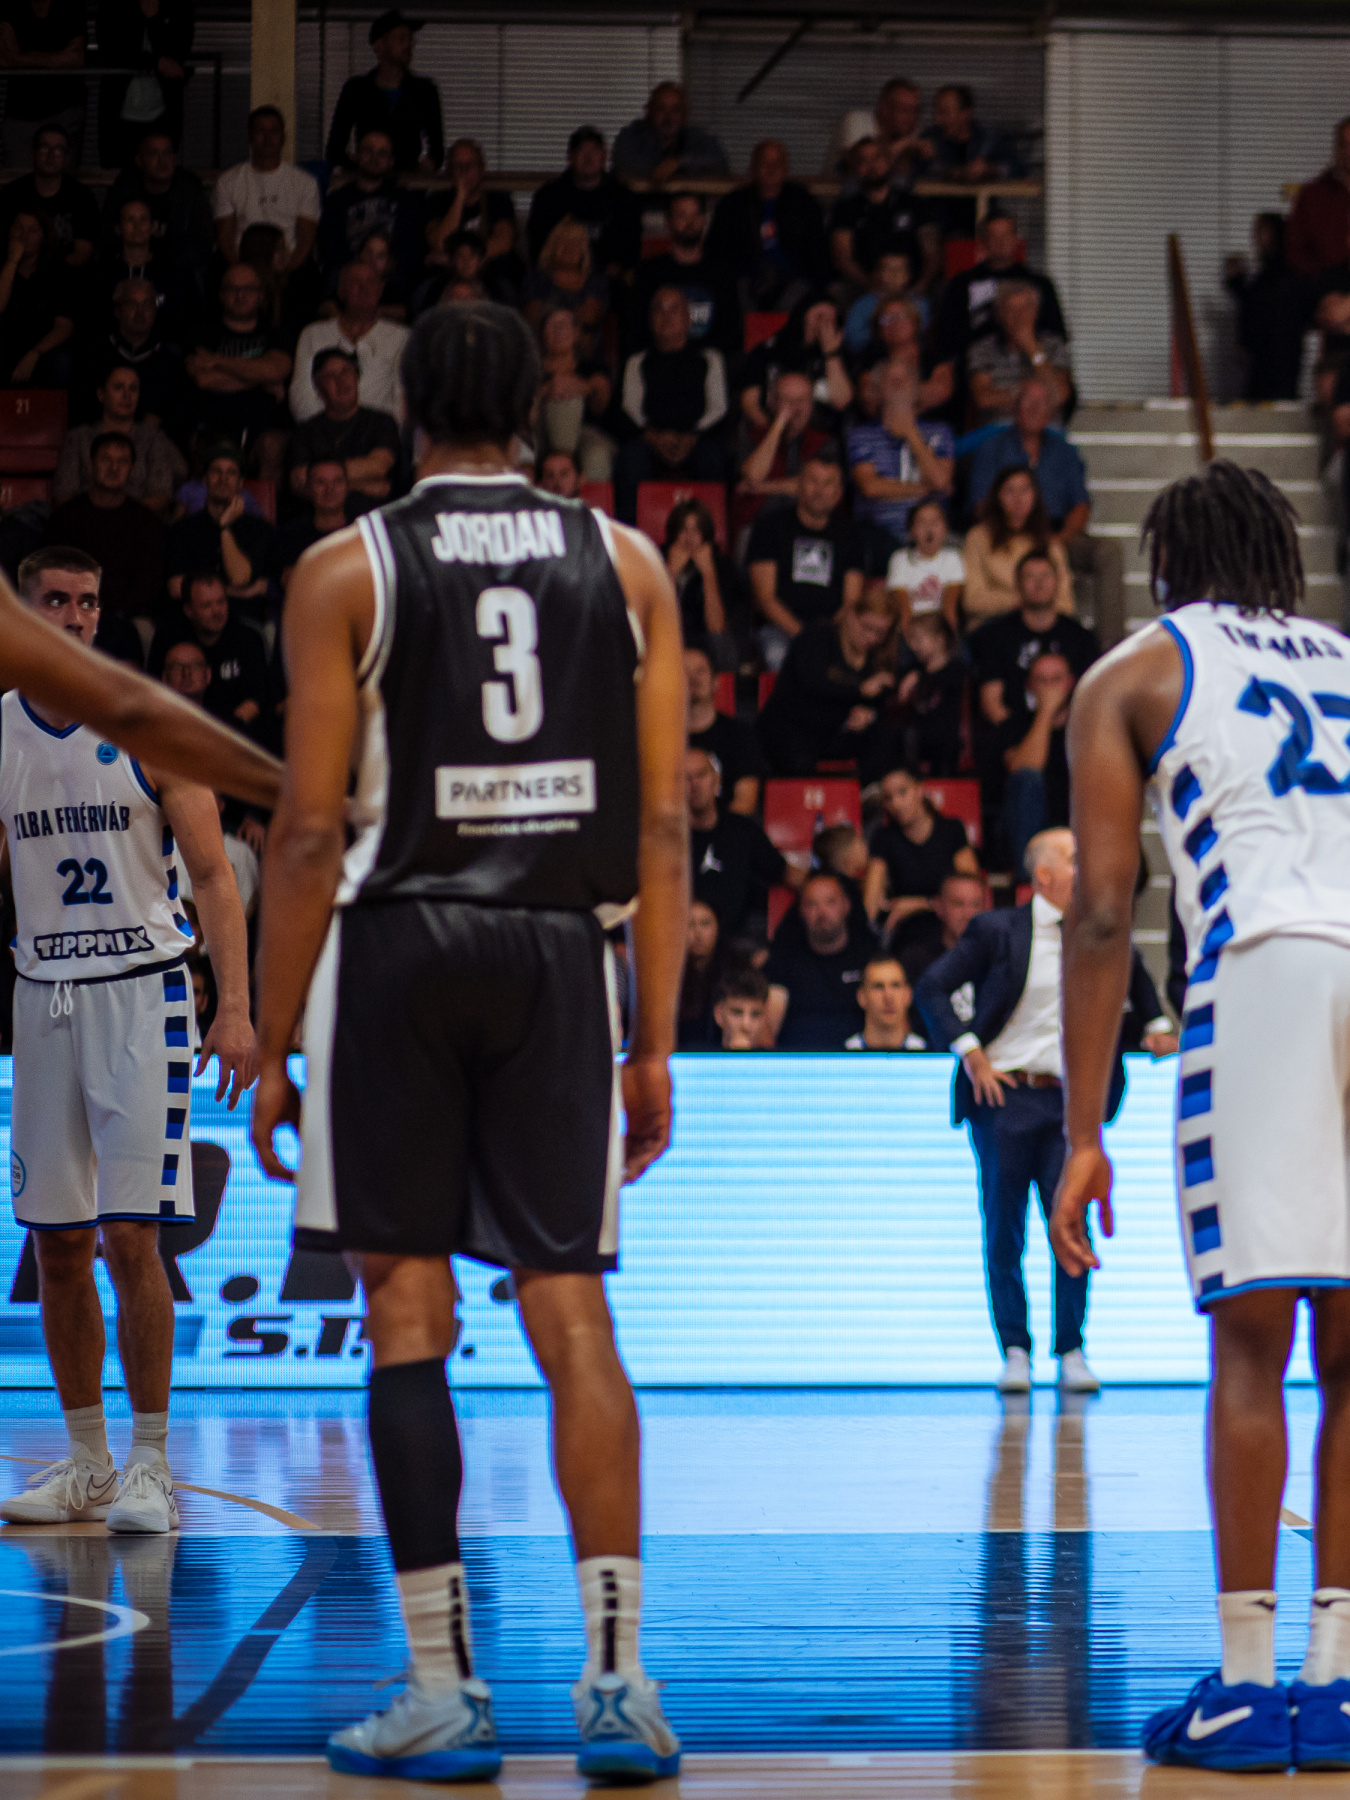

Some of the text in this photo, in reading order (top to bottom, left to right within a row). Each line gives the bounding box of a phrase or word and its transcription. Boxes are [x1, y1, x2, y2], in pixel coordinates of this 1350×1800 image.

[430, 509, 567, 565] JORDAN
[475, 585, 544, 744] 3
[1216, 622, 1343, 661] THMAS
[450, 774, 583, 802] PARTNERS
[56, 857, 114, 906] 22
